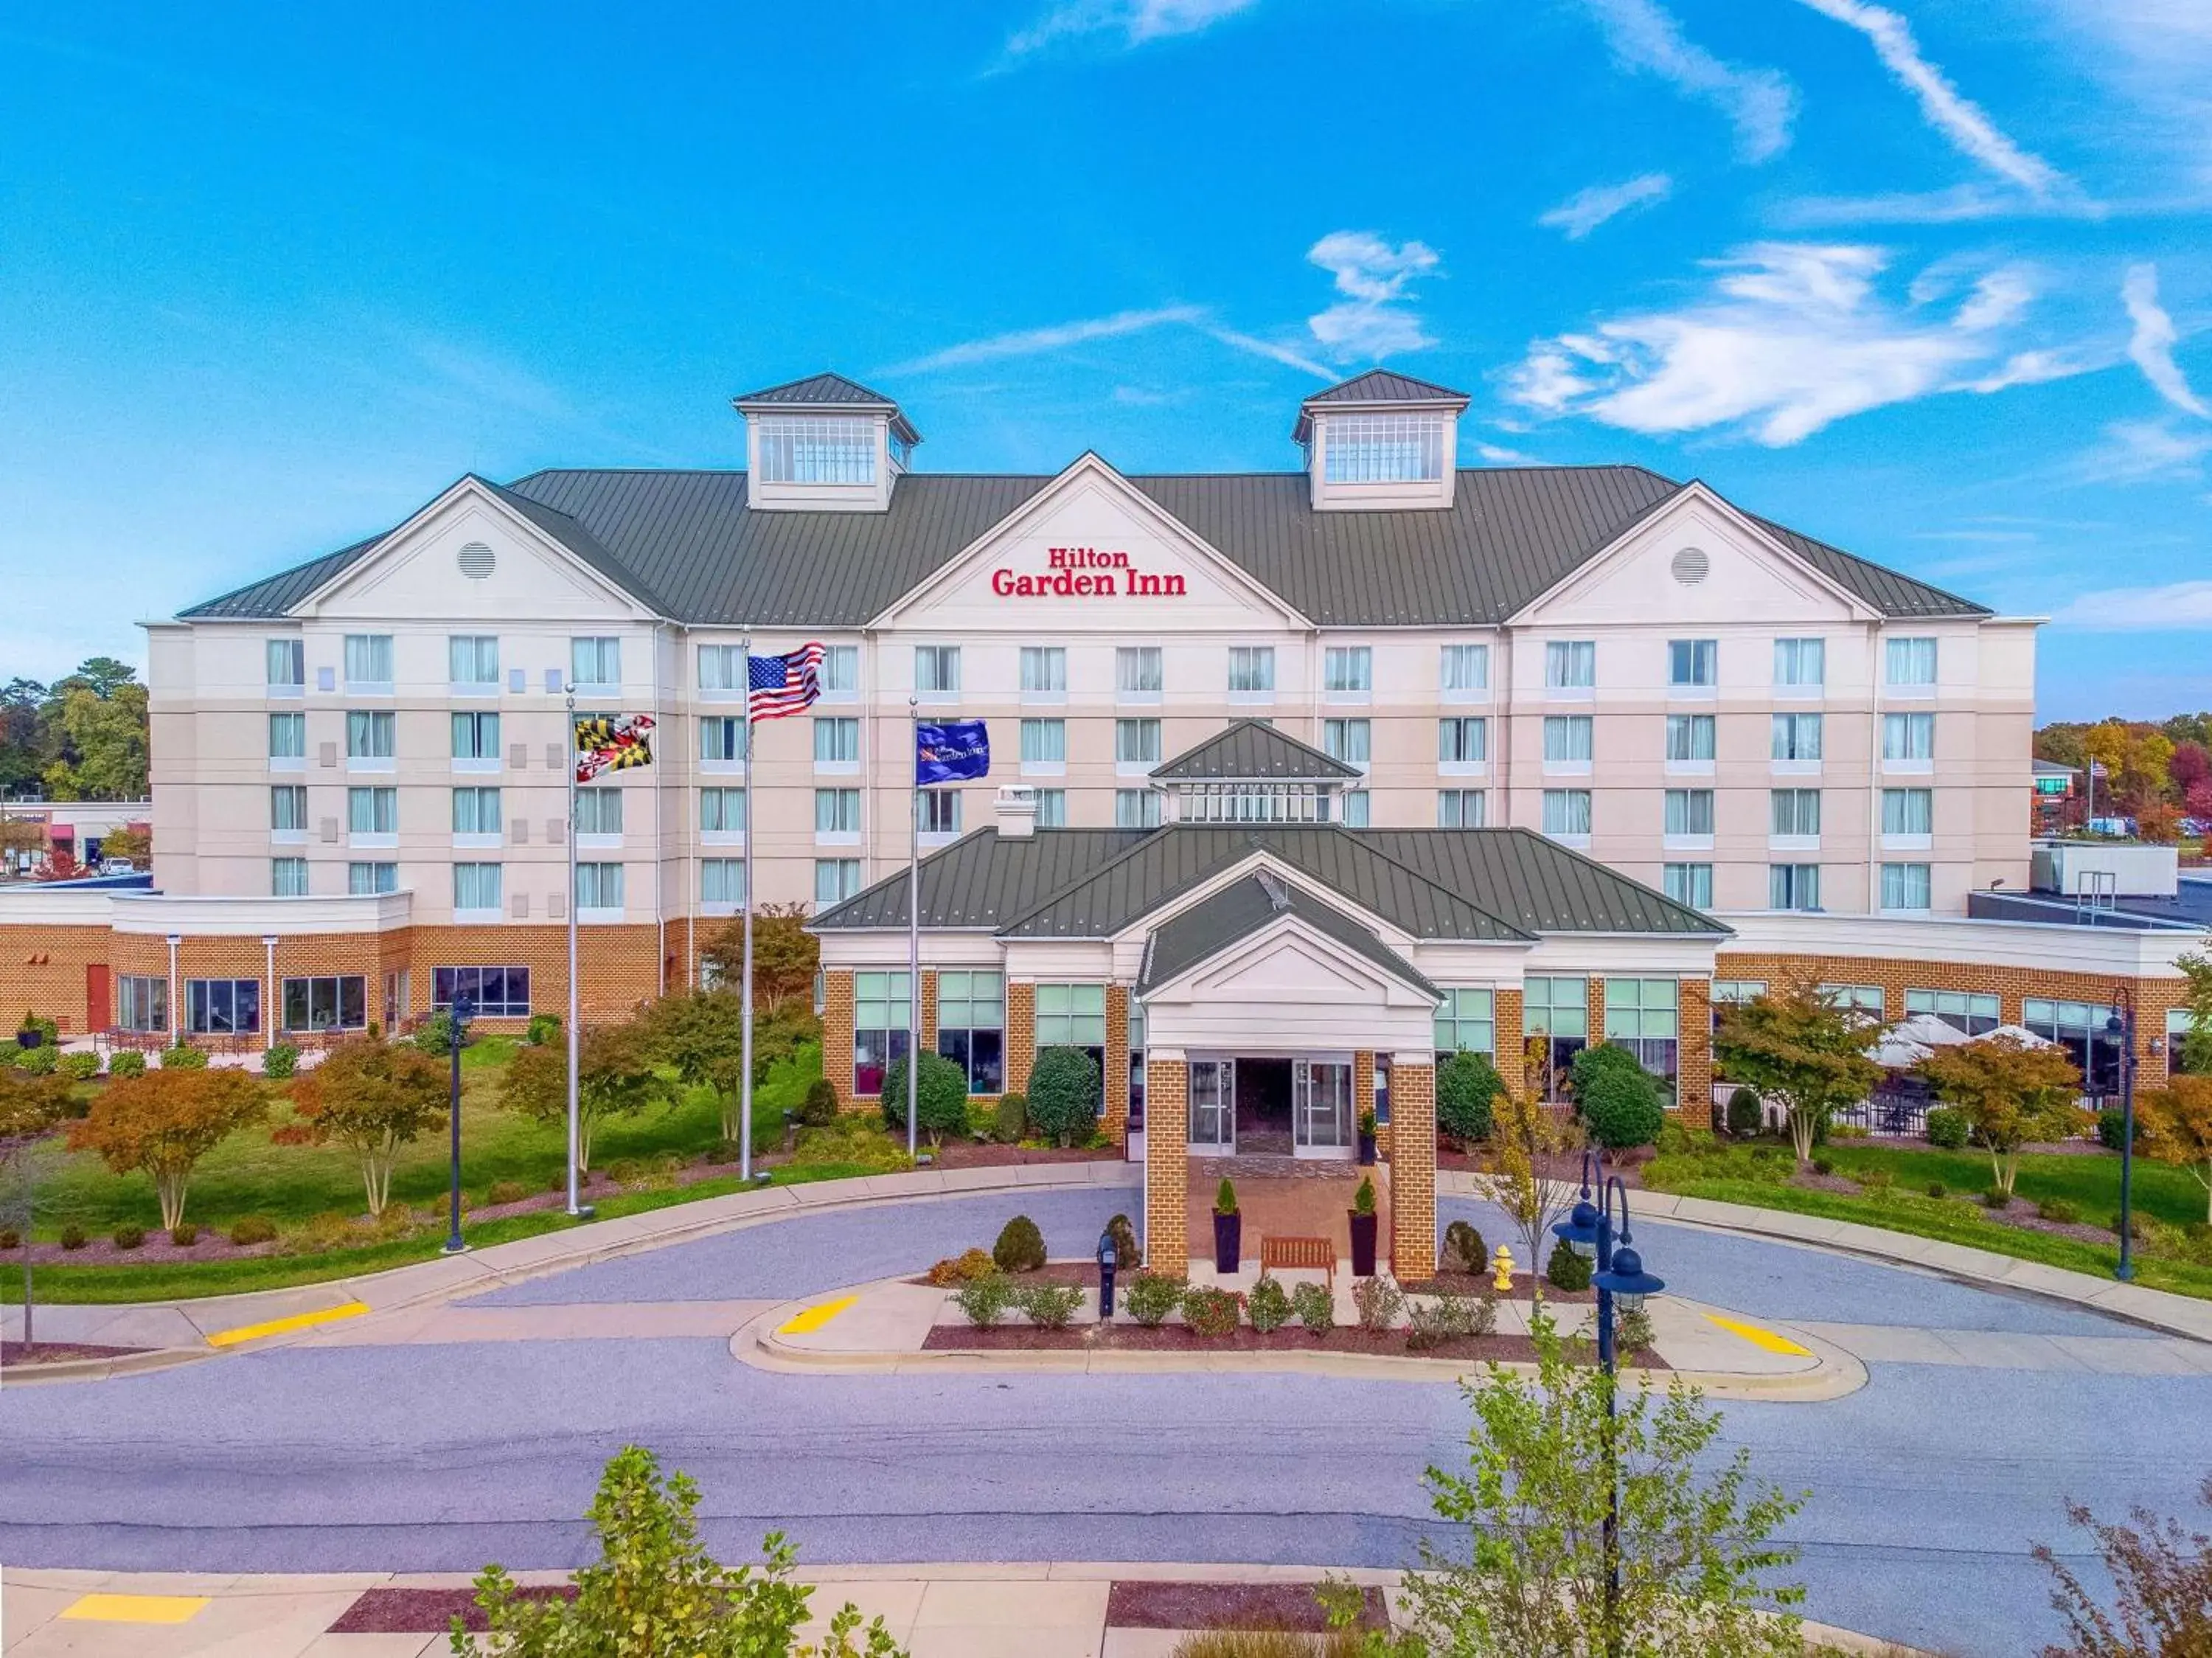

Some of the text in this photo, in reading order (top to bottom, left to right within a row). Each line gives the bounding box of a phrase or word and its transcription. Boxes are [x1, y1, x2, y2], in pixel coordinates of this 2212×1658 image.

[1048, 548, 1130, 568] Hilton
[992, 569, 1186, 596] Garden Inn
